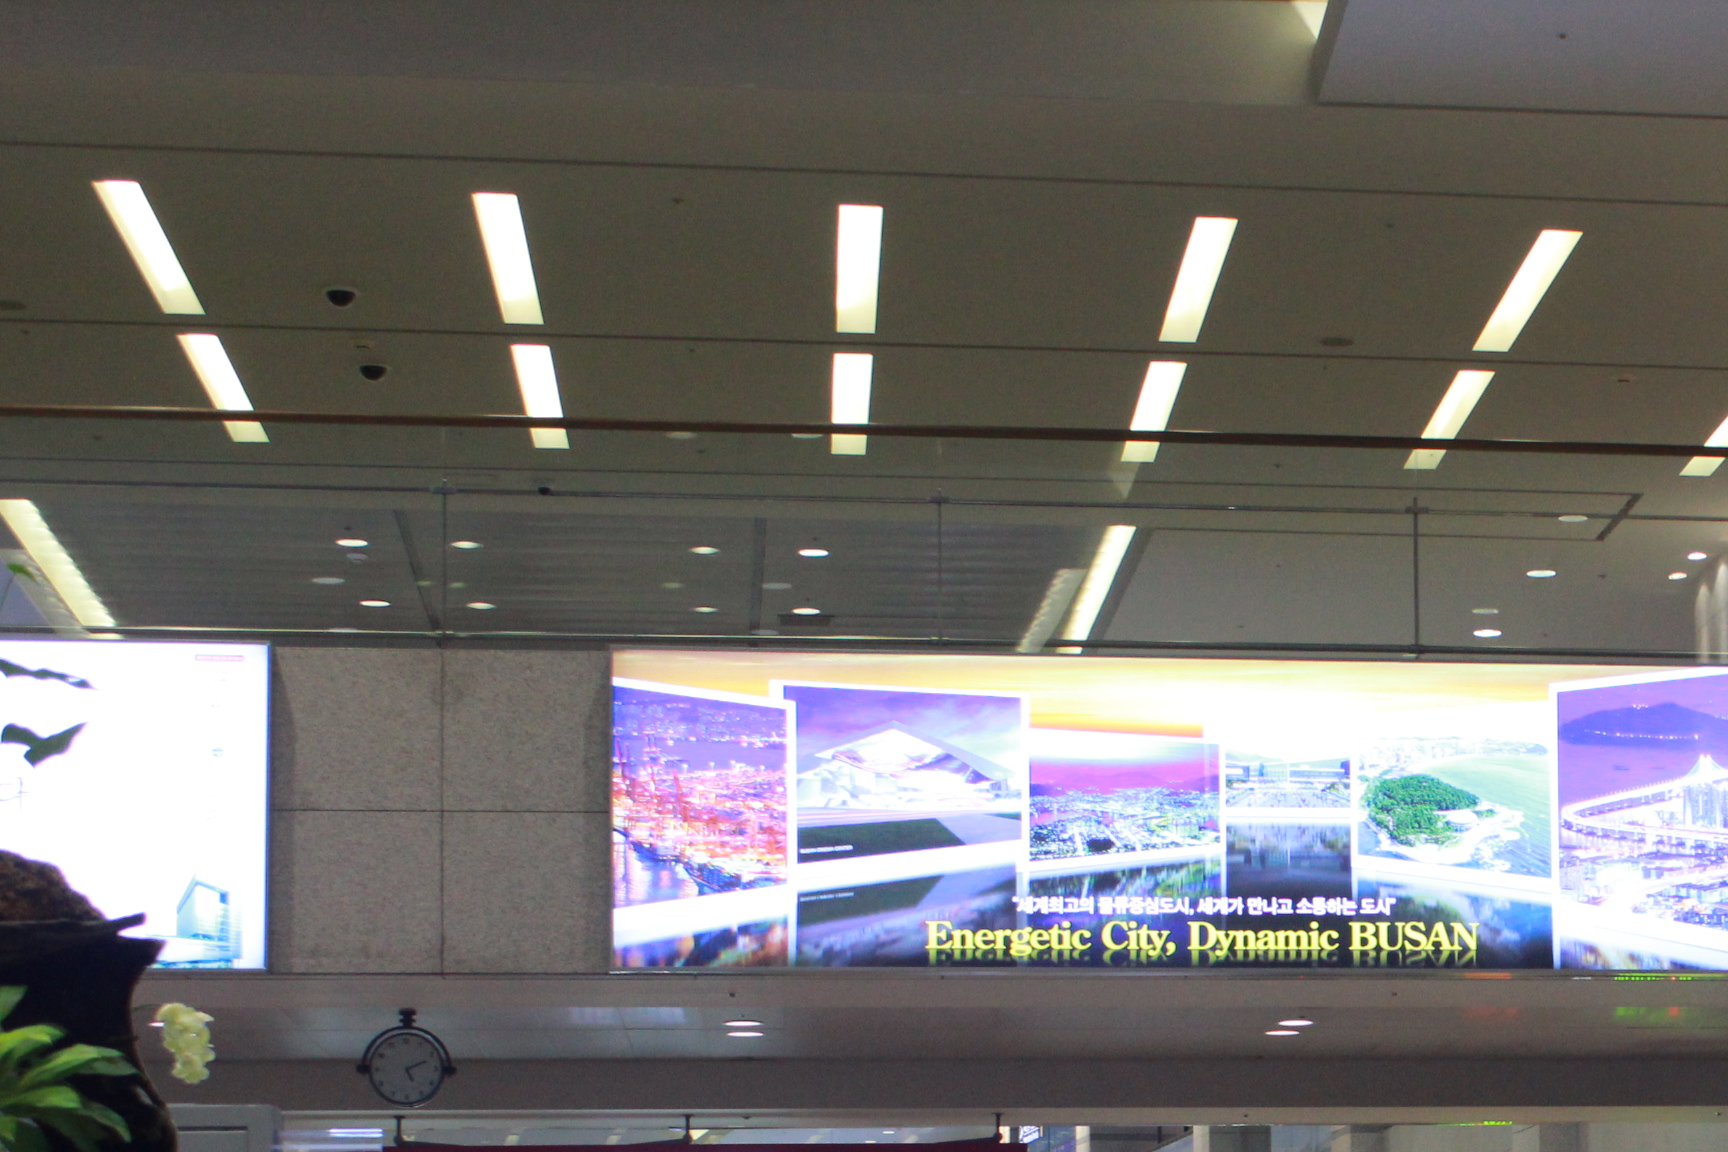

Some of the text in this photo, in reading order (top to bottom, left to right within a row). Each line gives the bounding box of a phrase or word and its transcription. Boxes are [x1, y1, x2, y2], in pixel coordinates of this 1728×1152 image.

[1196, 896, 1244, 916] 세계가
[1247, 896, 1294, 916] 만나고
[1296, 897, 1358, 916] 소통하는
[925, 920, 1480, 957] Energetic City, Dynamic BUSAN
